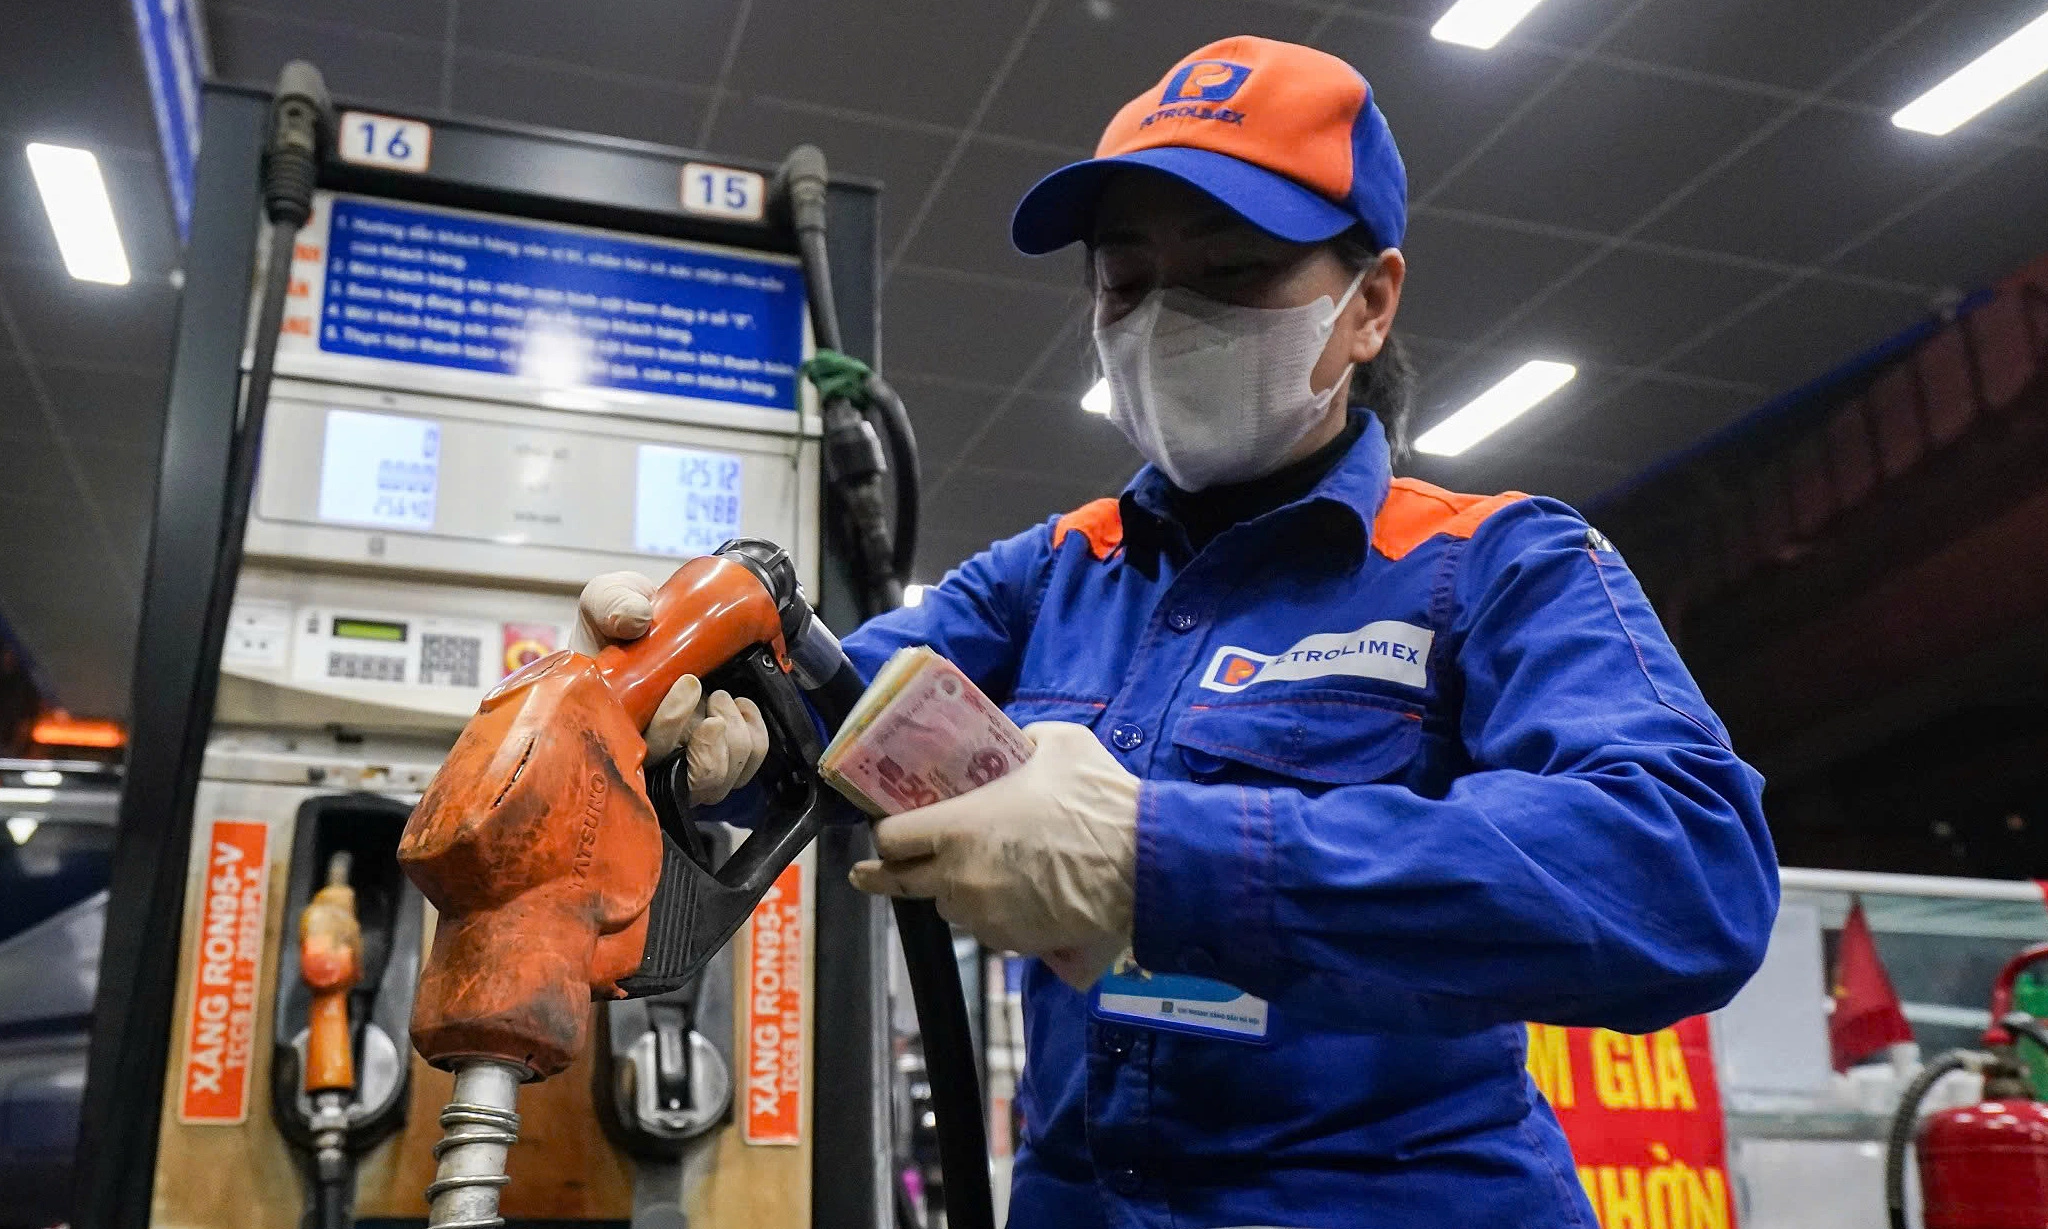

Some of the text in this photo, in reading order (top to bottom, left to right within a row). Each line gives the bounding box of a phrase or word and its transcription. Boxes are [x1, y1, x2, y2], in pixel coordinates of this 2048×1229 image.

[358, 121, 413, 161] 16
[699, 173, 749, 210] 15
[680, 457, 739, 490] 12512
[1274, 640, 1419, 666] ETROLIMEX
[202, 842, 244, 986] RON95-V
